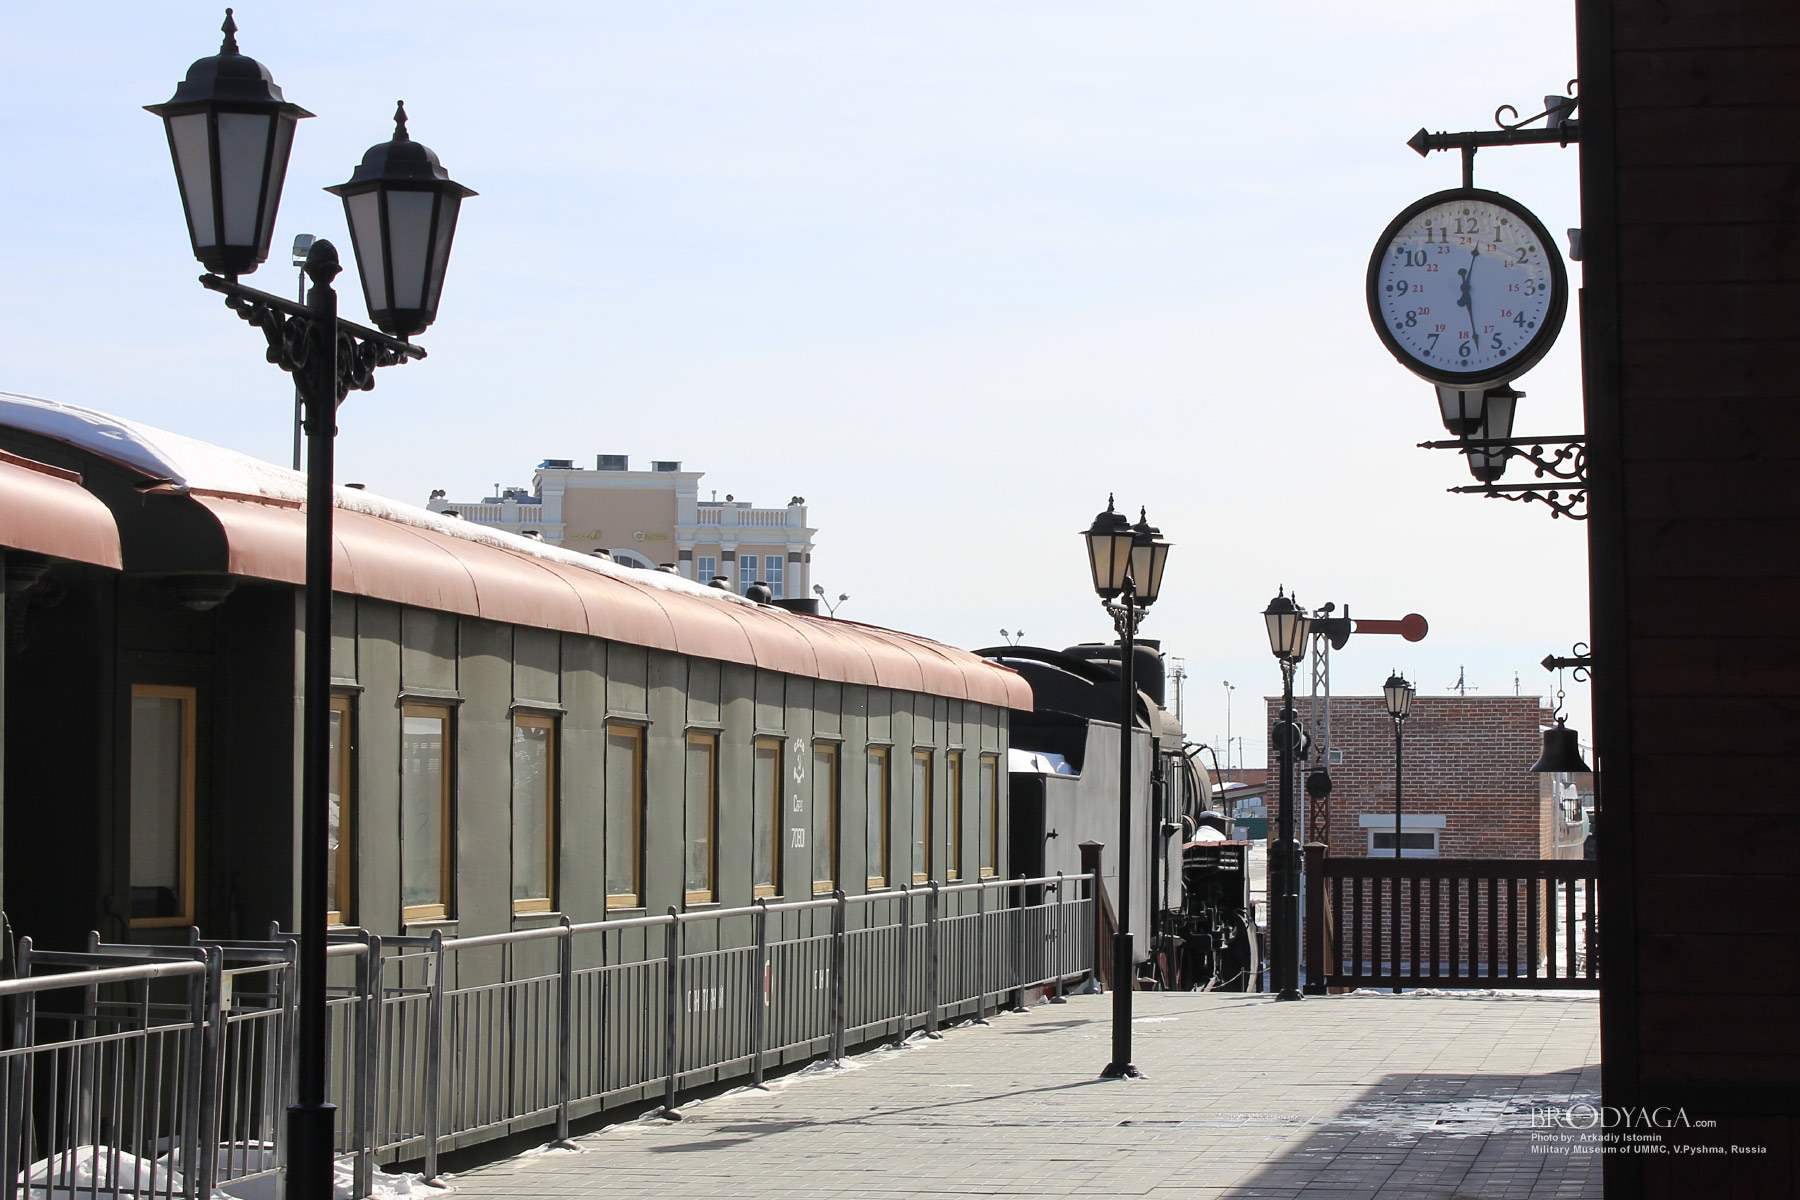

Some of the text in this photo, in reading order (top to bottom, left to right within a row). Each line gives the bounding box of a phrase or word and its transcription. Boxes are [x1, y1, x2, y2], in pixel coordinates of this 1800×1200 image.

[1454, 217, 1480, 234] 12
[1425, 227, 1449, 243] 11
[1493, 225, 1503, 242] 1
[1459, 237, 1472, 245] 24
[1437, 246, 1450, 254] 23
[1486, 244, 1497, 252] 13
[1404, 250, 1427, 267] 10
[1516, 248, 1528, 264] 2
[1427, 264, 1439, 272] 22
[1503, 260, 1514, 268] 14
[1396, 280, 1408, 297] 9
[1412, 284, 1424, 293] 21
[1508, 284, 1520, 292] 15
[1524, 278, 1536, 296] 3
[1418, 307, 1430, 315] 20
[1501, 310, 1512, 318] 16
[1405, 310, 1417, 327] 8
[1513, 311, 1526, 328] 4
[1435, 324, 1446, 332] 19
[1483, 325, 1495, 334] 17
[1458, 331, 1469, 339] 18
[1491, 332, 1502, 349] 5
[1427, 333, 1440, 351] 7
[1459, 340, 1471, 357] 6
